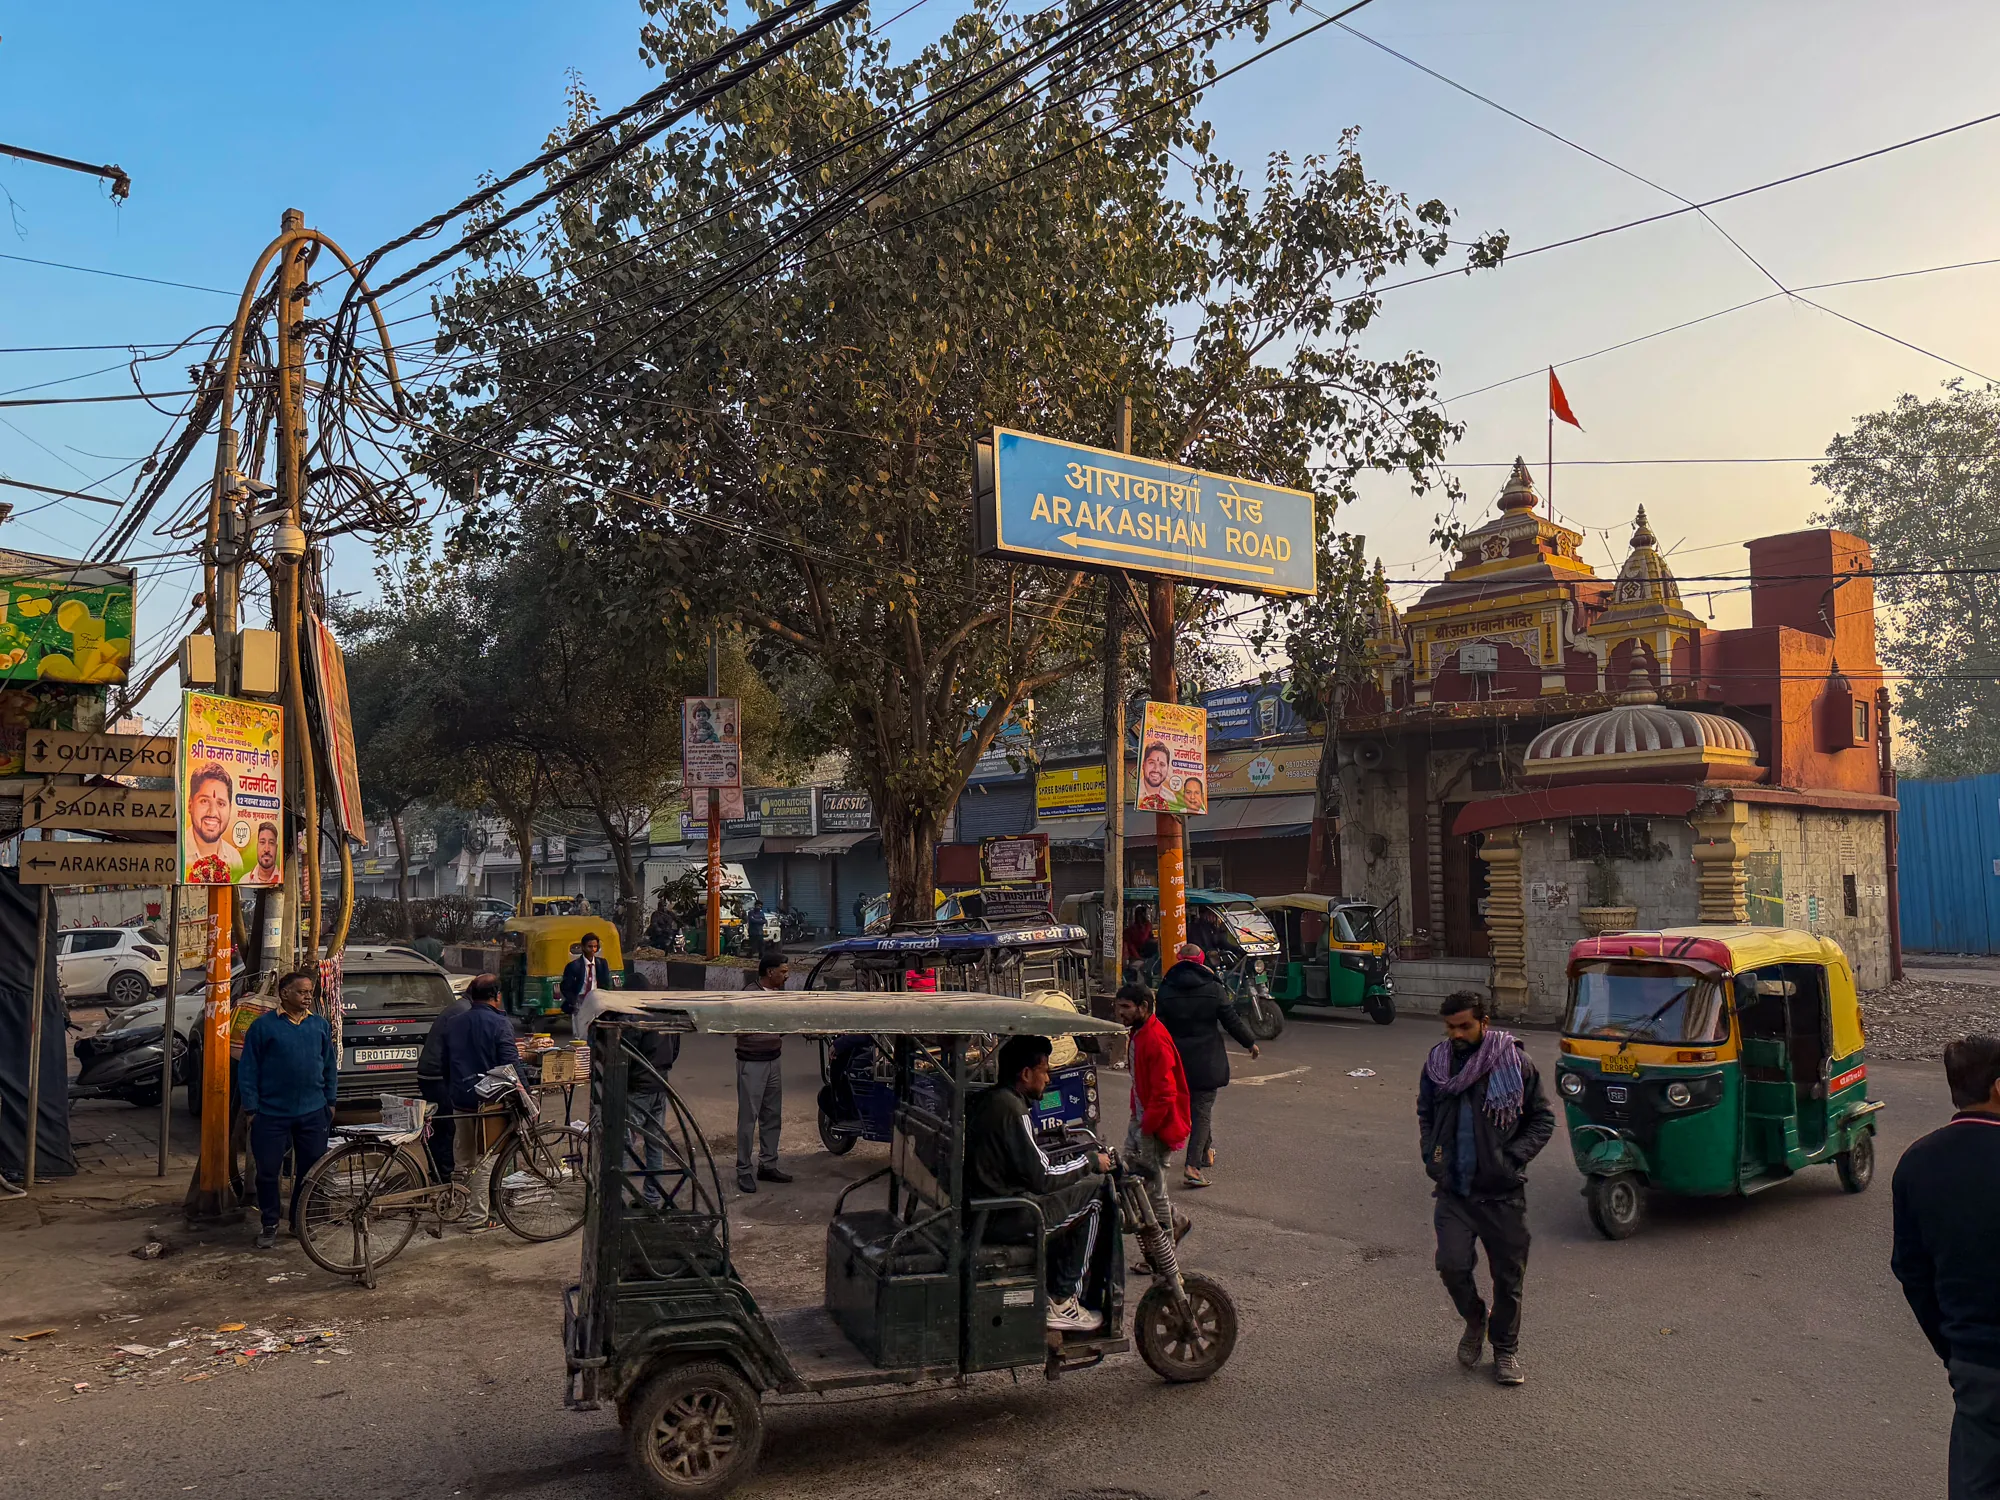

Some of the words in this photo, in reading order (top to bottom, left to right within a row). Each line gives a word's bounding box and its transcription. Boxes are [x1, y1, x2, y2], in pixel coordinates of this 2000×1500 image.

[1217, 484, 1263, 524] रोड
[1030, 493, 1207, 549] ARAKASHAN
[1225, 527, 1292, 562] ROAD
[1207, 698, 1223, 707] NEW
[57, 744, 134, 763] QUTAB
[141, 749, 177, 766] RO
[191, 739, 204, 759] श्री
[205, 745, 234, 761] कमल
[235, 747, 259, 769] बागड़ी
[260, 749, 271, 767] जी
[1173, 748, 1202, 762] जन्मदिन
[239, 773, 277, 794] जन्मदिन
[1038, 785, 1054, 795] SHREE
[1082, 781, 1106, 790] EQUIPME
[237, 797, 243, 805] 12
[786, 797, 811, 806] KITCHEN
[824, 796, 867, 811] CLASSIC
[55, 800, 125, 818] SADAR
[132, 803, 176, 819] BAZ
[773, 806, 808, 816] EQUIPMENTS
[60, 856, 150, 872] ARAKASHA
[155, 857, 176, 872] RO
[1016, 926, 1061, 941] सारथी
[877, 939, 895, 950] TRS
[900, 937, 939, 950] सारथी
[361, 1049, 417, 1061] BR01FT7799
[1040, 1117, 1063, 1131] TRS
